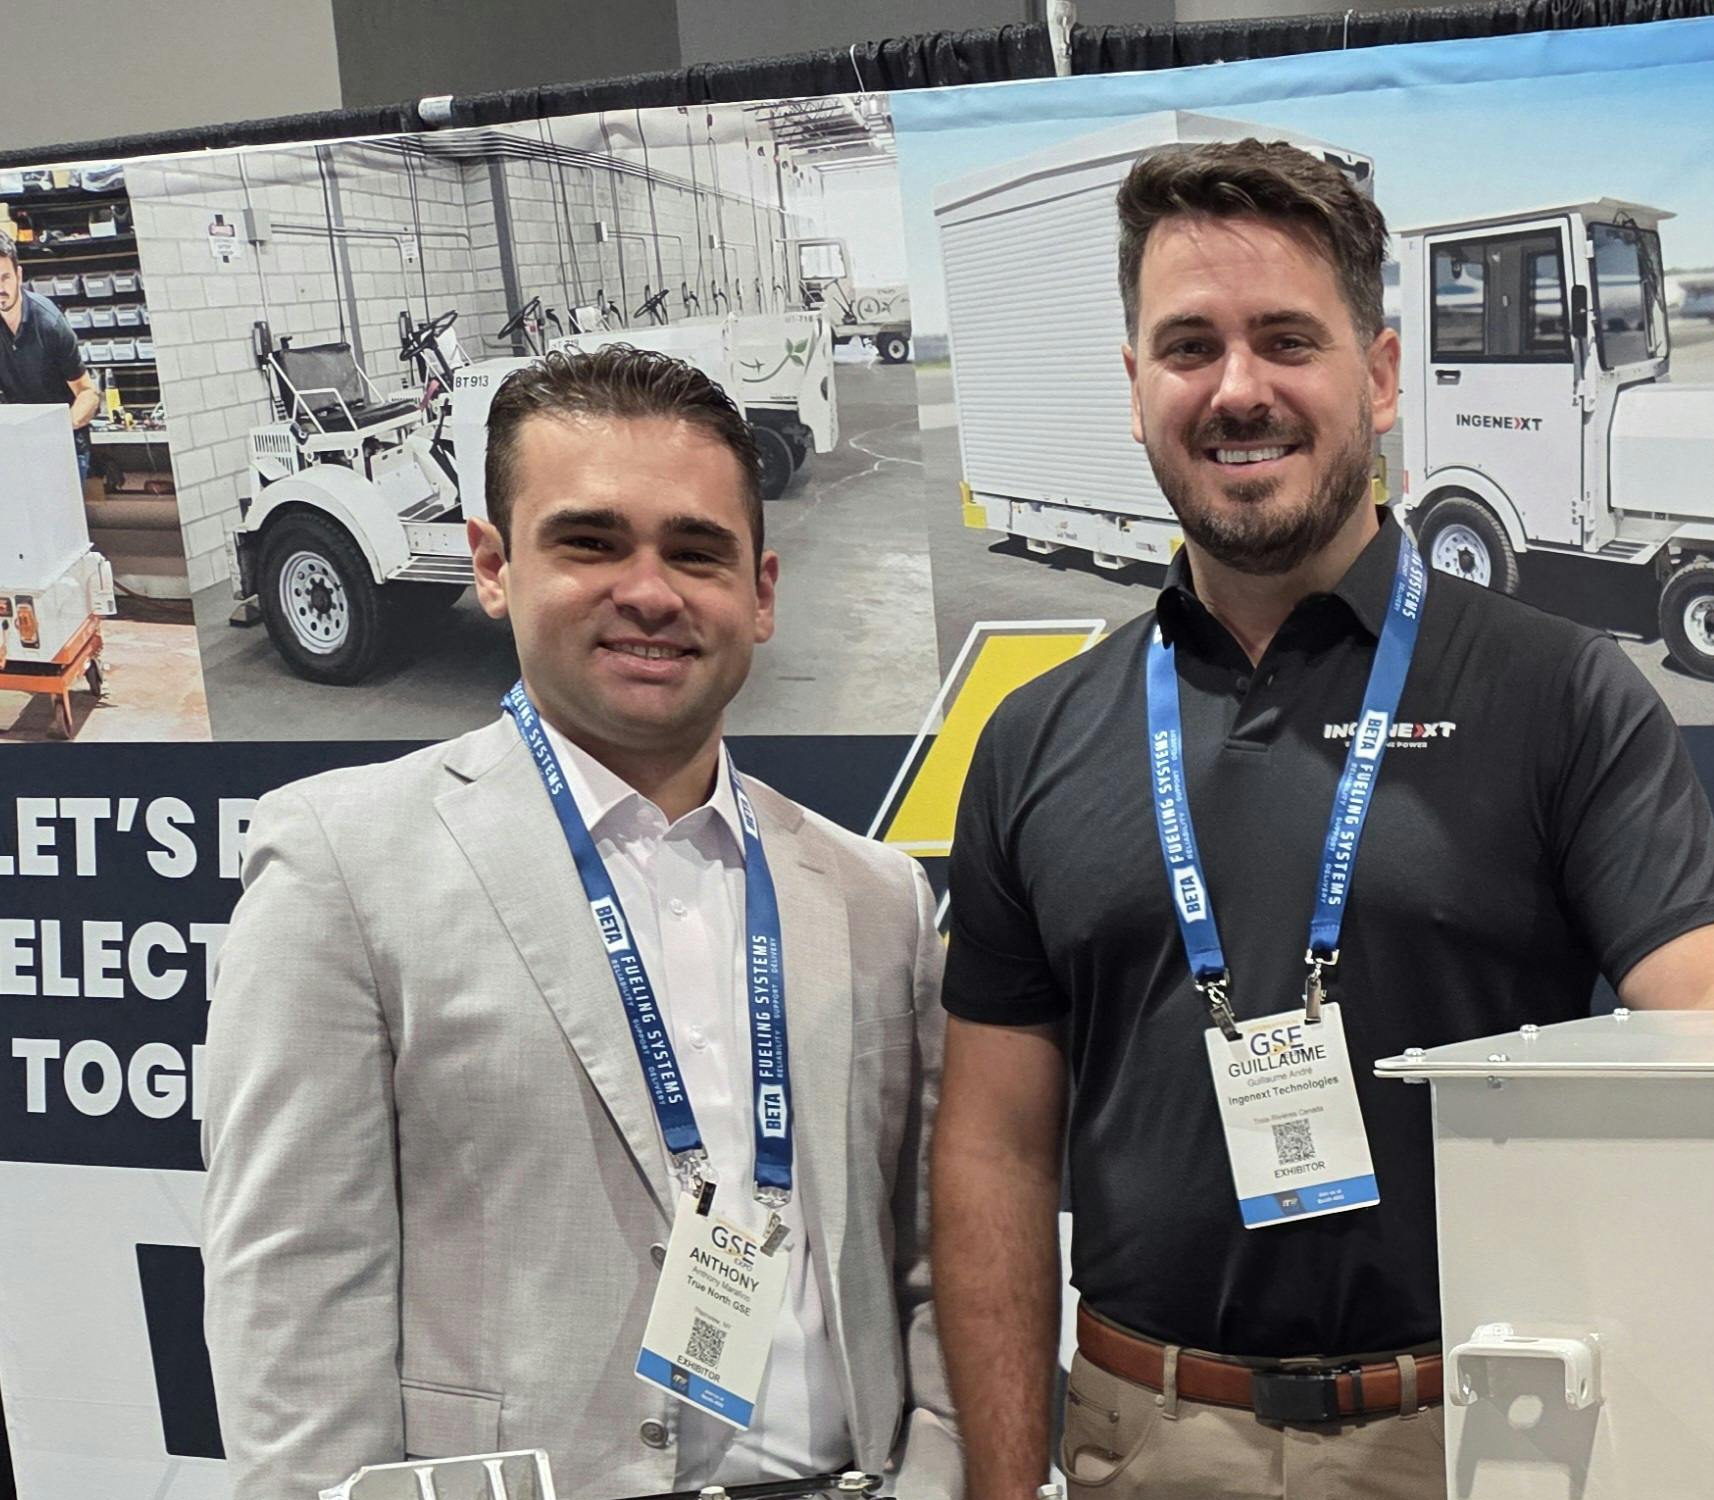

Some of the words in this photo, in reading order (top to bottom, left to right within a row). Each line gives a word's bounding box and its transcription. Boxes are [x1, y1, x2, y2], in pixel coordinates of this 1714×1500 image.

[1360, 718, 1383, 750] BETA
[1396, 741, 1428, 749] POWER
[529, 728, 564, 795] SYSTEMS
[1154, 730, 1173, 796] SYSTEMS
[1174, 769, 1184, 802] SUPPORT
[1344, 763, 1374, 826] FUELING
[1160, 797, 1184, 864] FUELING
[1178, 812, 1193, 860] RELIABILITY
[1328, 826, 1355, 907] SYSTEMS
[1182, 875, 1202, 914] BETA
[595, 905, 624, 945] BETA
[0, 918, 230, 1001] ELECT
[752, 934, 769, 1005] SYSTEMS
[769, 937, 778, 974] DELIVERY
[773, 983, 782, 1020] SUPPORT
[611, 959, 635, 1006] RELIABILITY
[632, 1018, 651, 1056] SUPPORT
[648, 1066, 667, 1105] DELIVERY
[620, 955, 657, 1023] FUELING
[647, 1029, 684, 1104] SYSTEMS
[756, 1010, 775, 1078] FUELING
[1251, 1025, 1304, 1056] GSE
[775, 1029, 784, 1079] RELIABILITY
[1228, 1045, 1327, 1078] GUILLAUME
[1228, 1089, 1271, 1106] Ingenext
[1272, 1075, 1340, 1098] Technologies
[1247, 1072, 1287, 1088] Guillaume
[765, 1092, 783, 1132] BETA
[1274, 1160, 1326, 1179] EXHIBITOR
[711, 1225, 758, 1266] GSE
[689, 1247, 760, 1293] ANTHONY
[686, 1275, 706, 1292] True
[707, 1287, 732, 1306] North
[732, 1300, 752, 1317] GSE
[676, 1354, 722, 1383] EXHIBITOR
